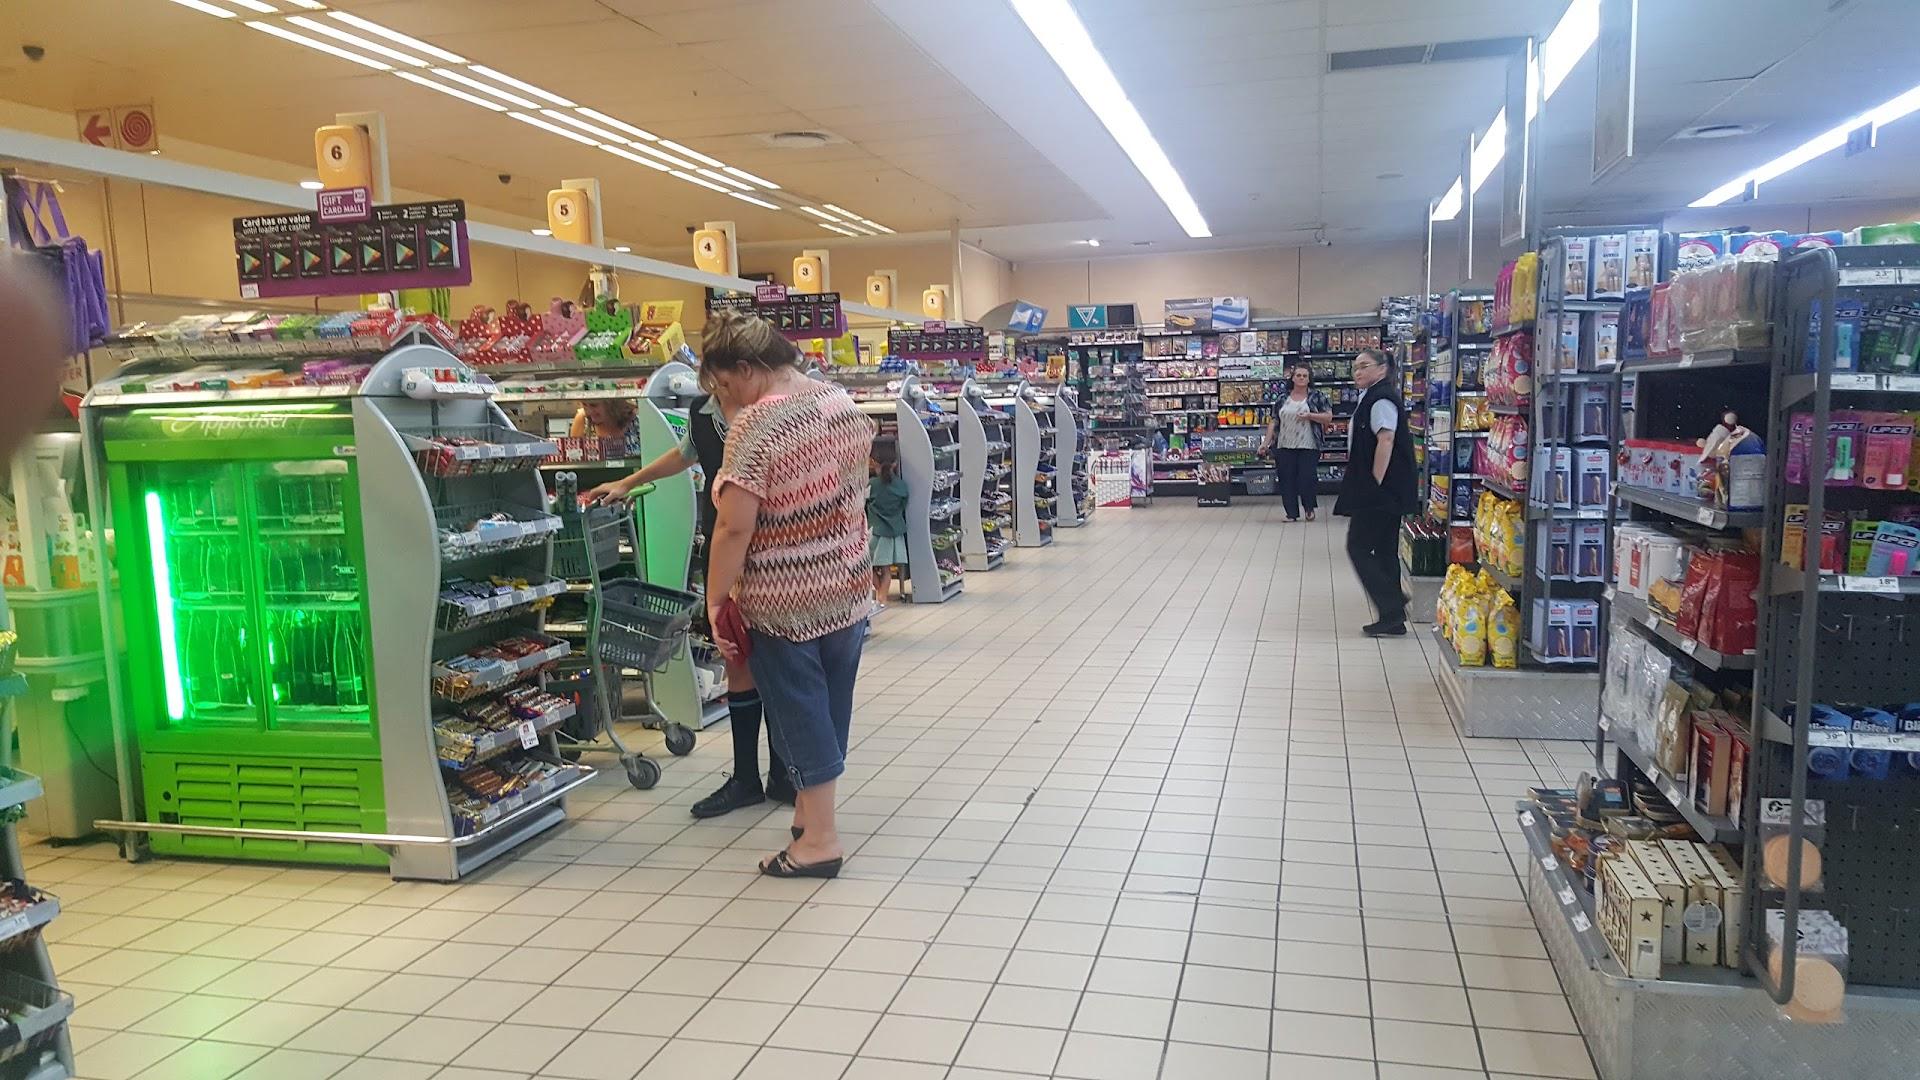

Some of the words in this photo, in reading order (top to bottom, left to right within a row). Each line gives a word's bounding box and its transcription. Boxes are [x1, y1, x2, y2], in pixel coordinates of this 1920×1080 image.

[331, 145, 343, 160] 6
[323, 196, 342, 206] GIFT
[323, 206, 342, 215] CARD
[343, 204, 362, 213] MALL
[402, 209, 409, 219] 2
[431, 206, 438, 217] 3
[560, 204, 569, 216] 5
[242, 218, 260, 228] Card
[262, 217, 276, 226] has
[277, 216, 287, 224] no
[289, 214, 311, 223] value
[243, 227, 258, 236] until
[258, 225, 279, 234] loaded
[289, 222, 311, 232] cashier
[704, 242, 712, 252] 4
[802, 267, 809, 276] 3
